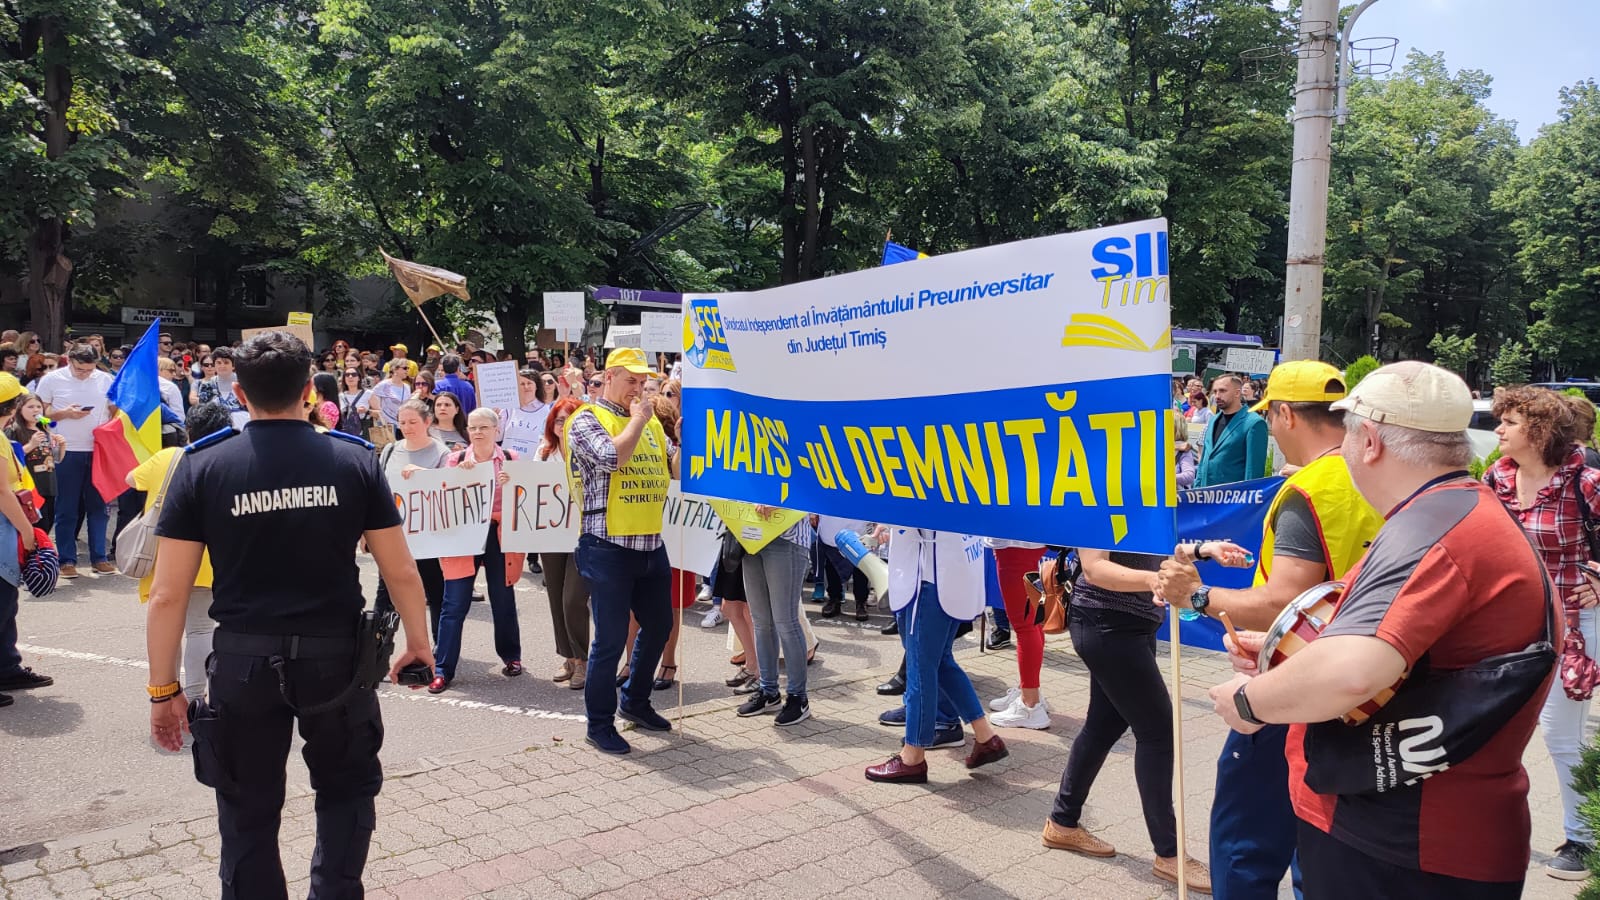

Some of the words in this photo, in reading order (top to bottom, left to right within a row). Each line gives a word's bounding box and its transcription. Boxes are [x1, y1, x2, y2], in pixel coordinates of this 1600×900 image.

[619, 290, 641, 301] 1017
[723, 314, 748, 331] Sindicatul
[749, 314, 799, 335] Independent
[800, 310, 811, 328] al
[811, 294, 914, 328] Învățământului
[917, 272, 1055, 309] Preuniversitar
[133, 315, 184, 325] ALIMNTAR
[137, 309, 179, 317] MAGAZIN
[787, 338, 803, 354] din
[804, 332, 847, 356] Județul
[848, 327, 887, 349] Timiș
[621, 480, 639, 490] DIN
[231, 485, 339, 516] JANDARMERIA
[1186, 489, 1264, 504] DEMOCRATE
[1384, 722, 1395, 756] National
[1371, 737, 1382, 764] Space
